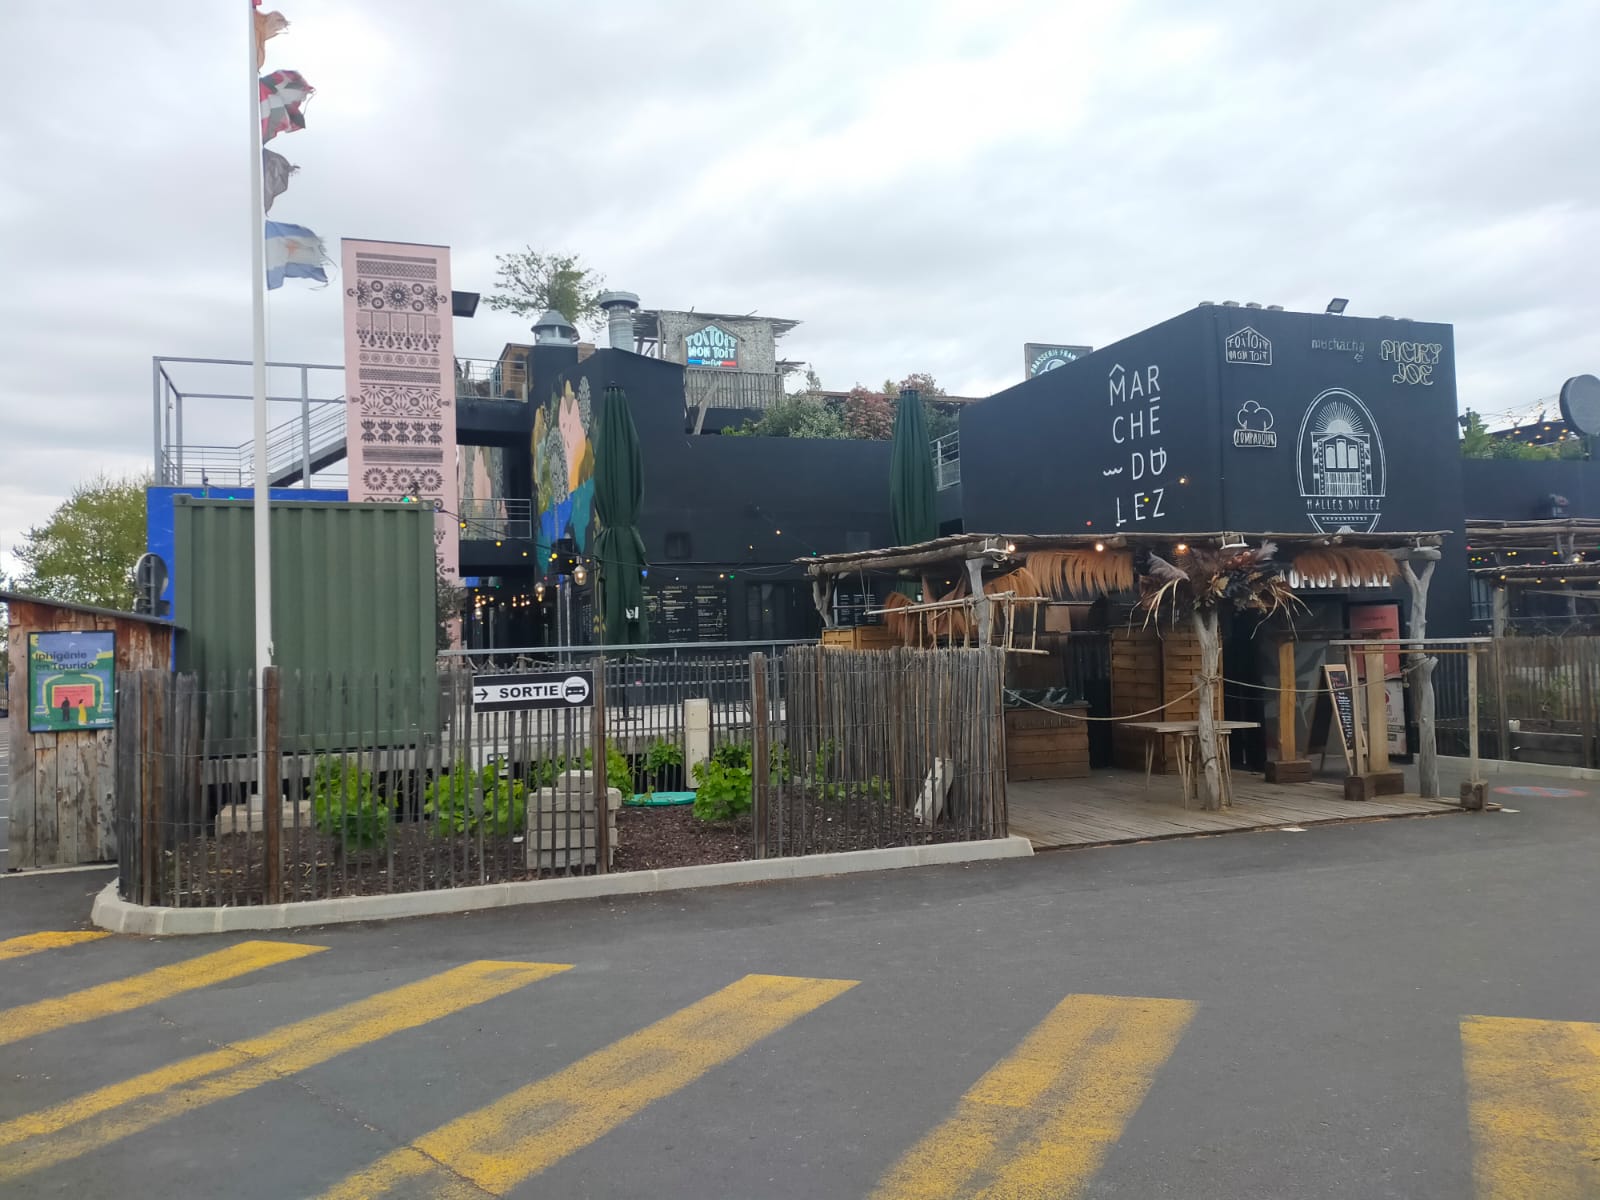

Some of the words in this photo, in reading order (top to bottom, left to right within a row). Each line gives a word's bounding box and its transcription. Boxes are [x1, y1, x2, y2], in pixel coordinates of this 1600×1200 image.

[1392, 362, 1434, 386] JOE
[1131, 446, 1167, 481] DU
[1116, 487, 1166, 525] LEZ
[1306, 499, 1343, 511] HALLES
[1348, 499, 1360, 510] DU
[1364, 499, 1381, 511] LEZ
[499, 684, 560, 699] SORTIE
